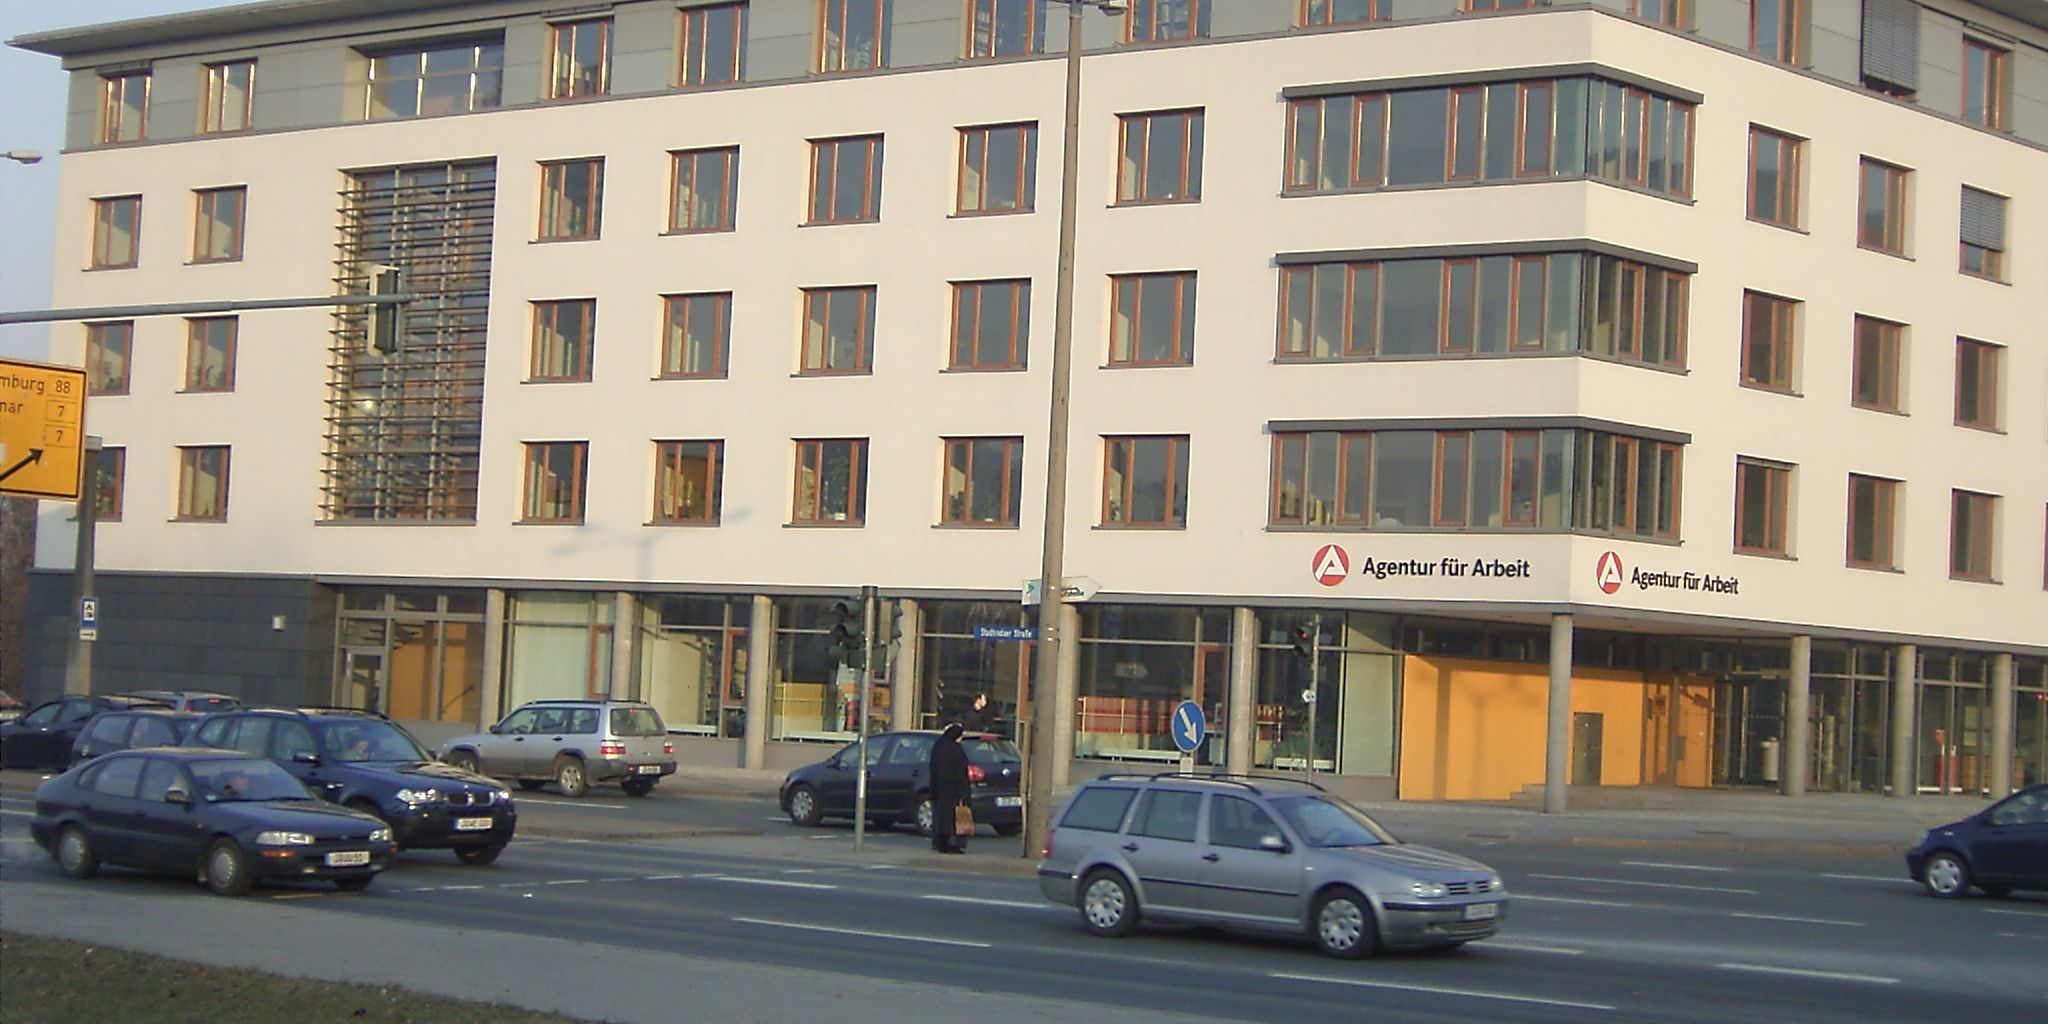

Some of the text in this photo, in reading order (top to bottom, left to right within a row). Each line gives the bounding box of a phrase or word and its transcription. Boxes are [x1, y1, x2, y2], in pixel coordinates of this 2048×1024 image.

[55, 379, 71, 393] 88
[57, 405, 65, 418] 7
[56, 430, 63, 442] 7
[1362, 557, 1530, 580] Agentur für Arbeit
[1631, 566, 1739, 595] Agentur für Arbeit
